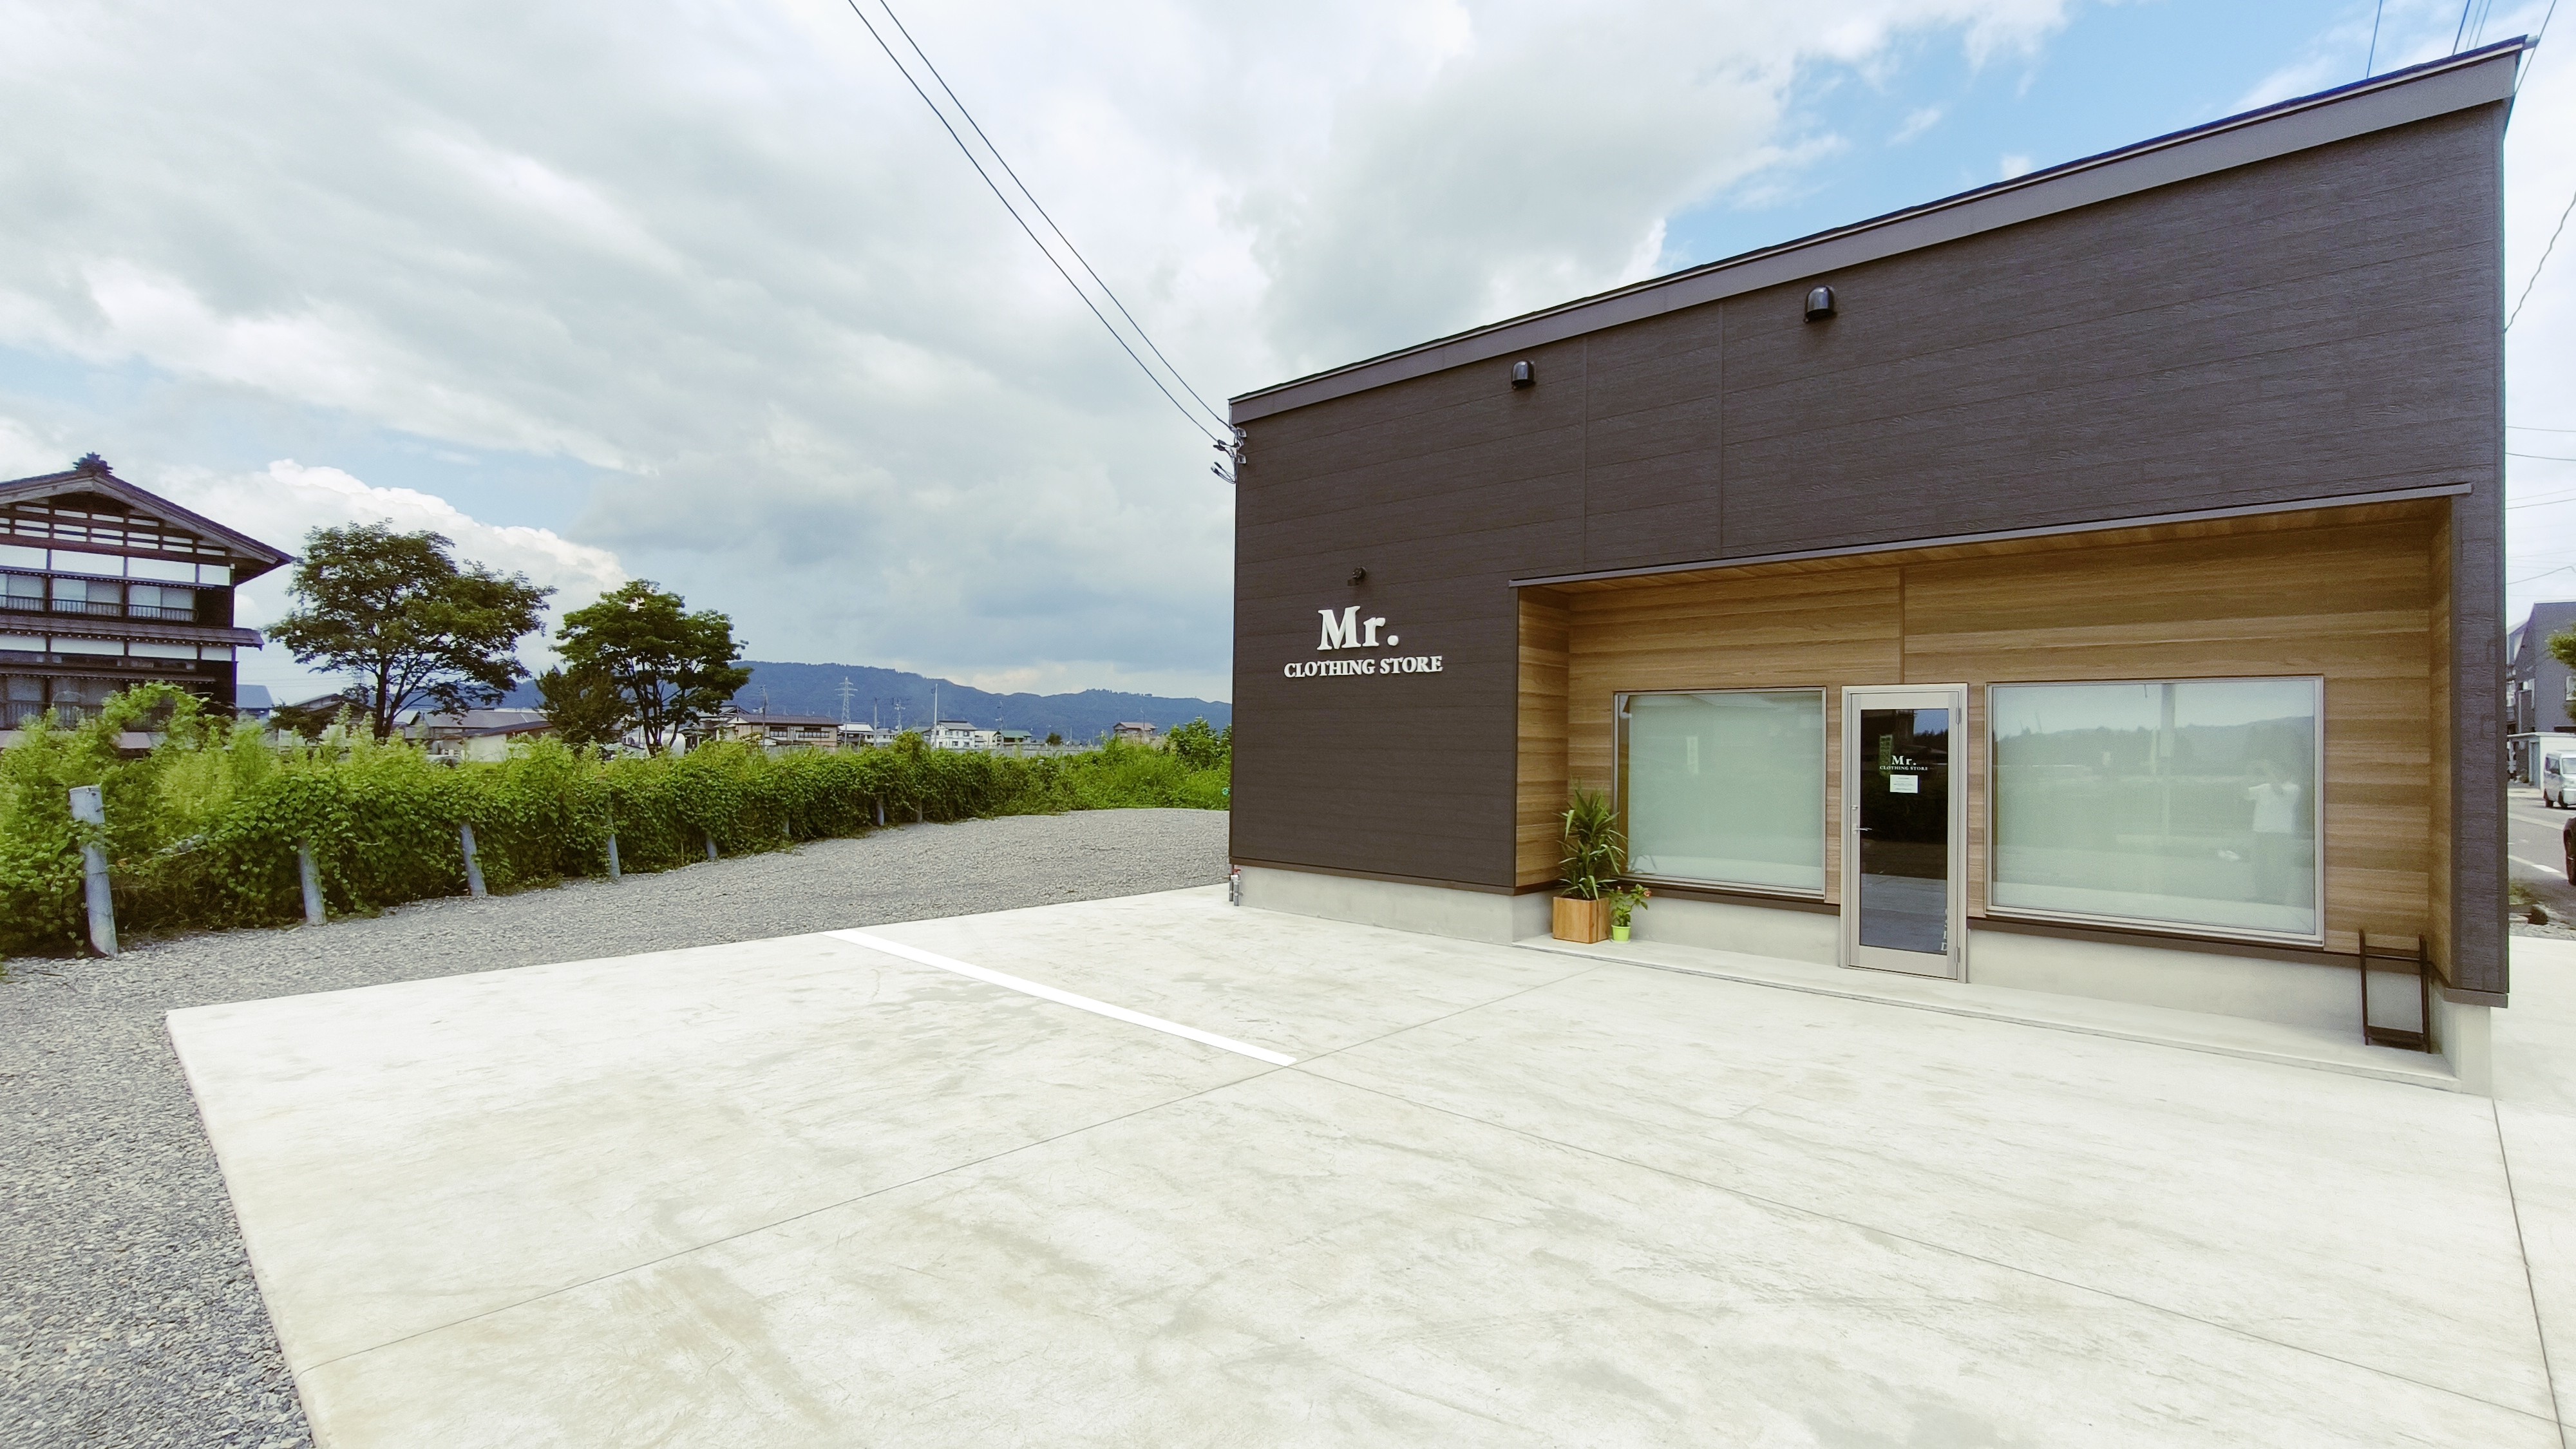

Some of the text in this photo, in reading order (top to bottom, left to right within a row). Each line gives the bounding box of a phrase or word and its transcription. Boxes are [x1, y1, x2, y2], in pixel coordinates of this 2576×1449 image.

[1316, 605, 1399, 650] Mr.
[1283, 655, 1443, 677] CLOTHING STORE
[1891, 755, 1917, 766] Mr.
